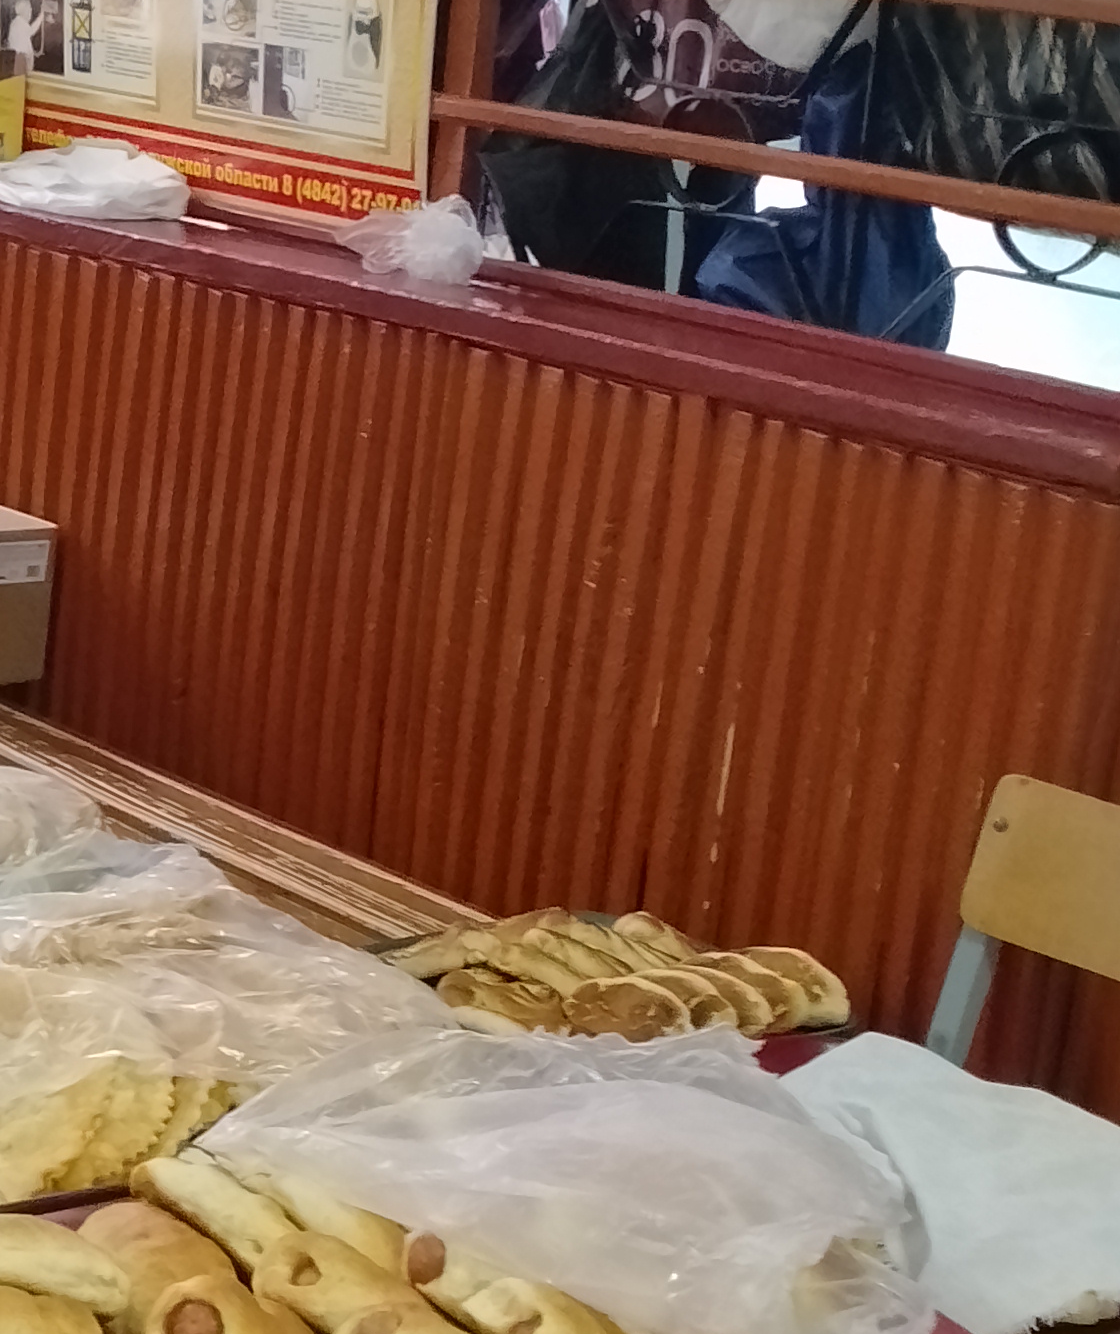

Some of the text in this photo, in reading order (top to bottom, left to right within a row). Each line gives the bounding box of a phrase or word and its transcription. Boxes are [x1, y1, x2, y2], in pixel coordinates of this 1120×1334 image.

[215, 162, 279, 193] области
[282, 173, 293, 196] 8
[296, 176, 348, 213] (4842)
